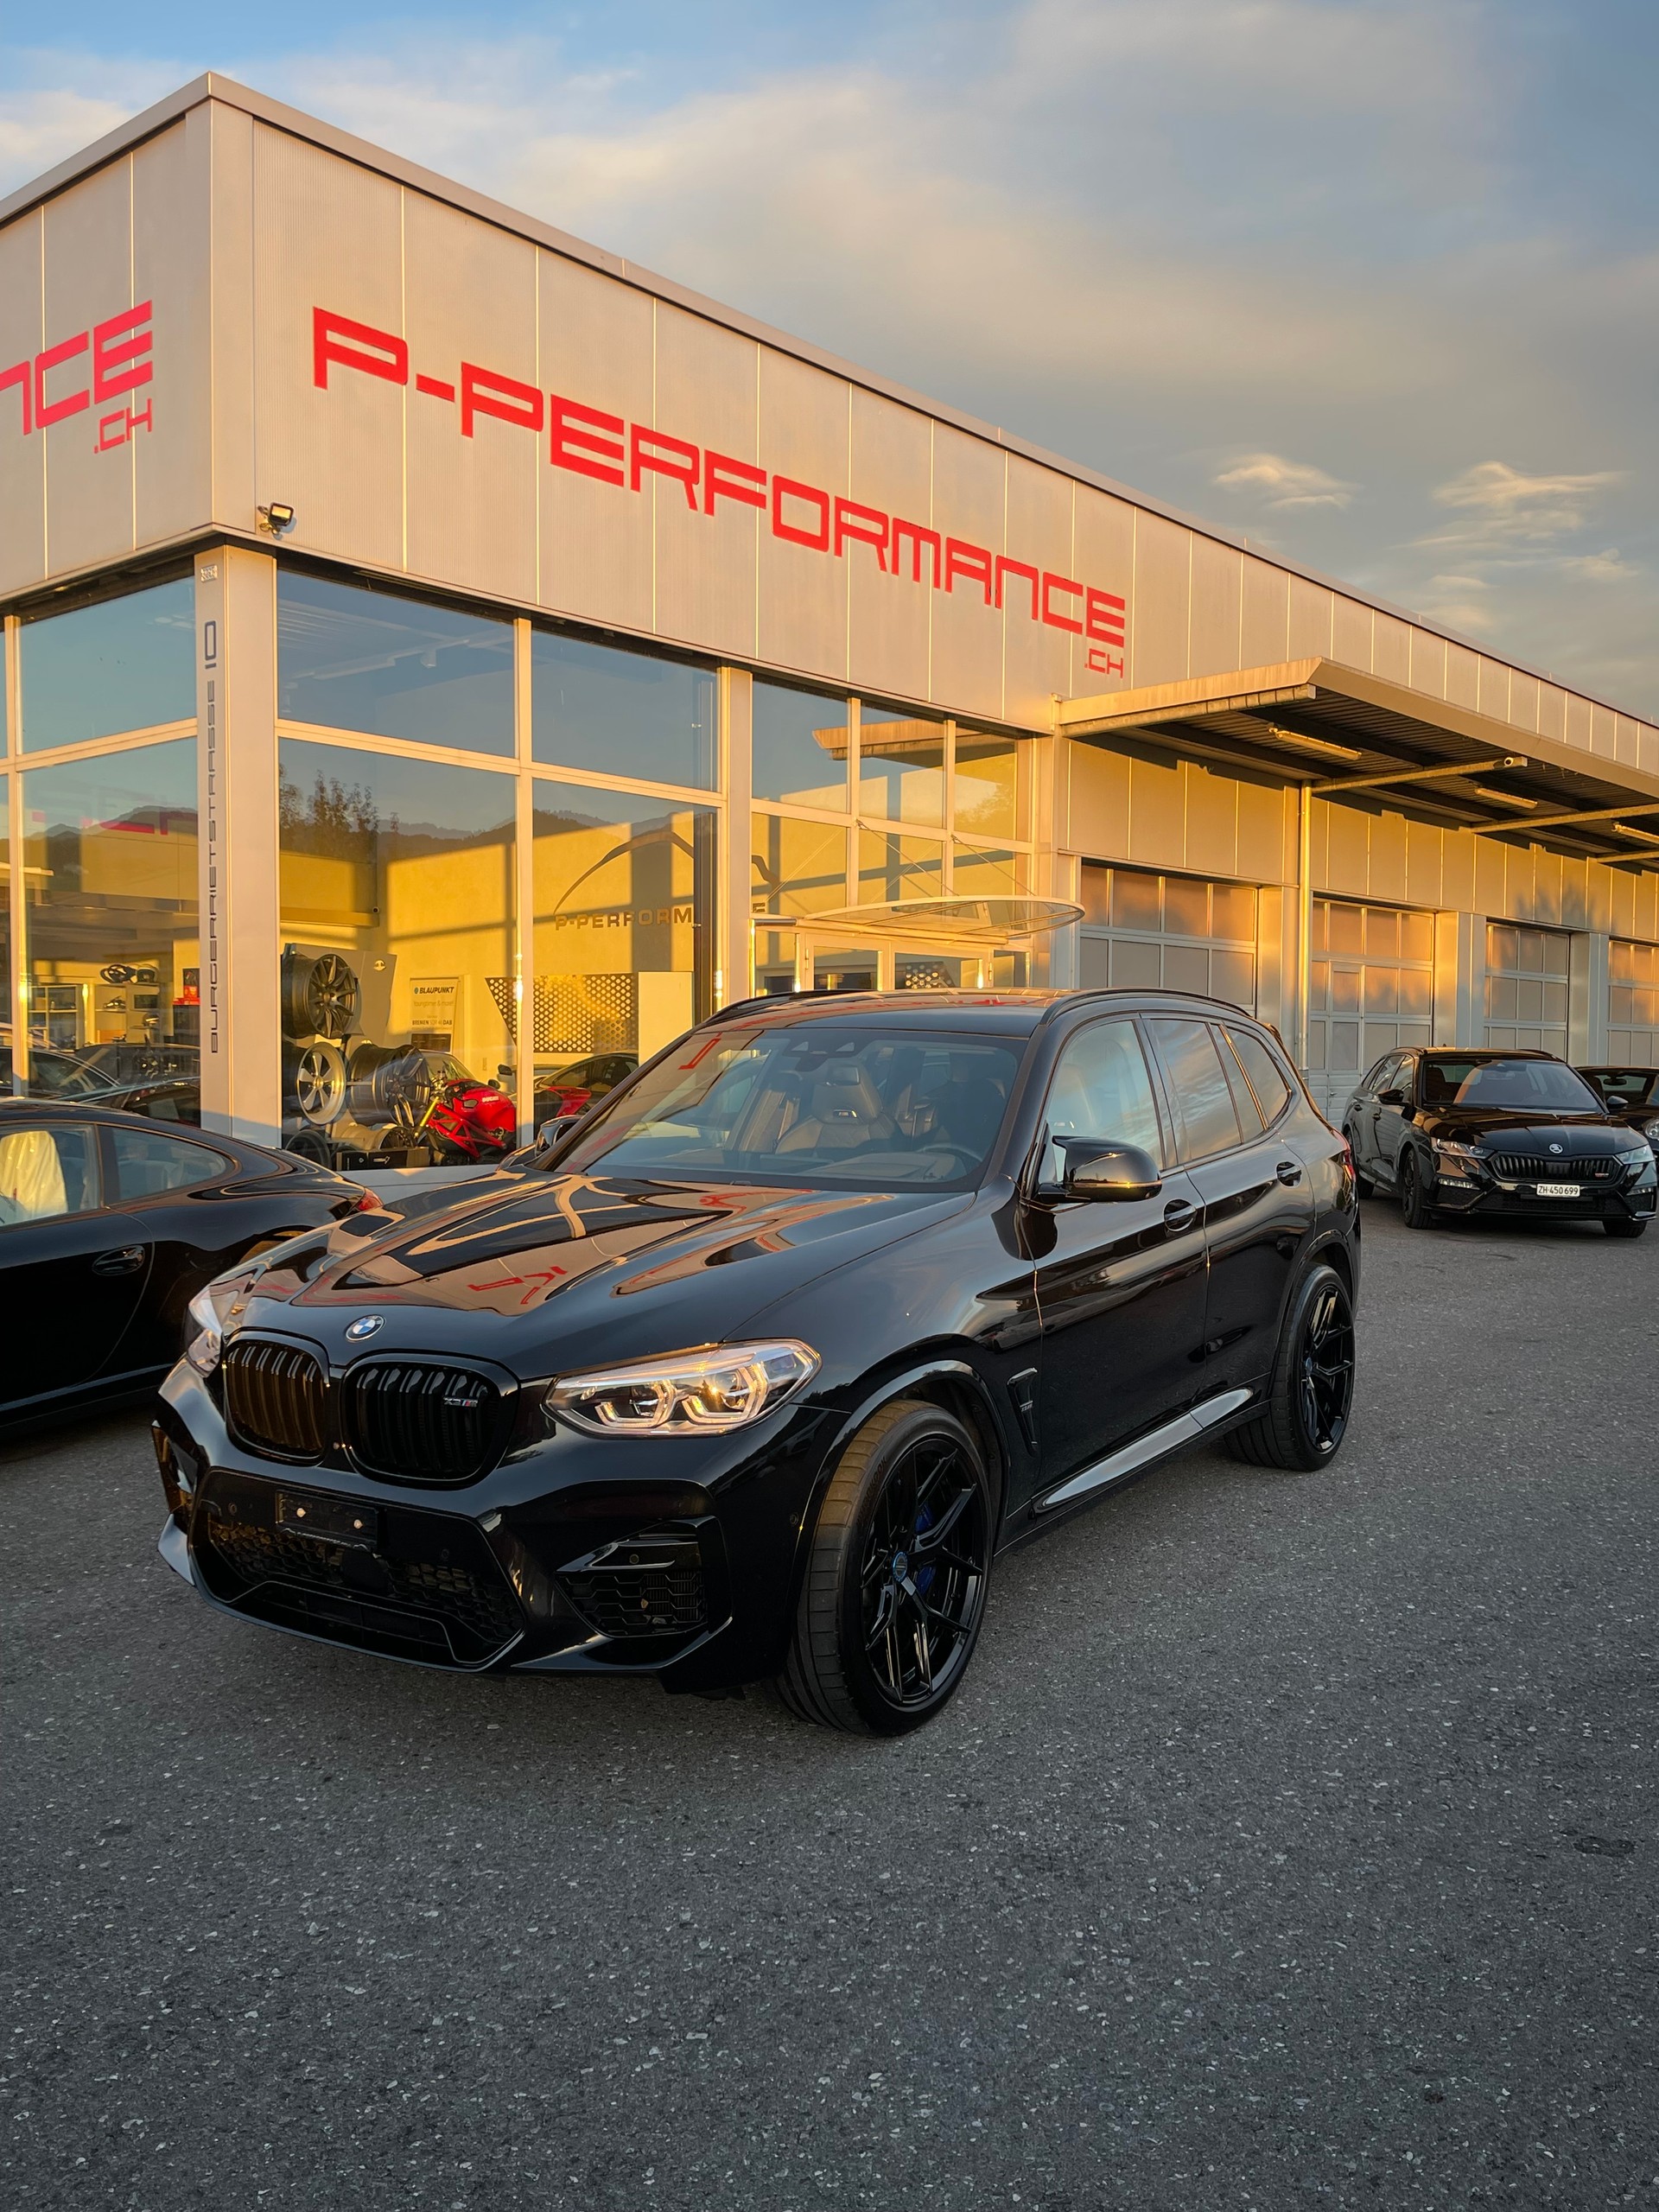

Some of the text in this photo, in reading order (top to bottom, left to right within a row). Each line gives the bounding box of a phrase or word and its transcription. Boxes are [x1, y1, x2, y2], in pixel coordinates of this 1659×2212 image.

[94, 398, 152, 454] .CH
[313, 306, 1125, 648] P-PERFORMANCE
[1084, 649, 1123, 678] .CH
[204, 620, 219, 1053] BURGERRIETSTRASSE 10
